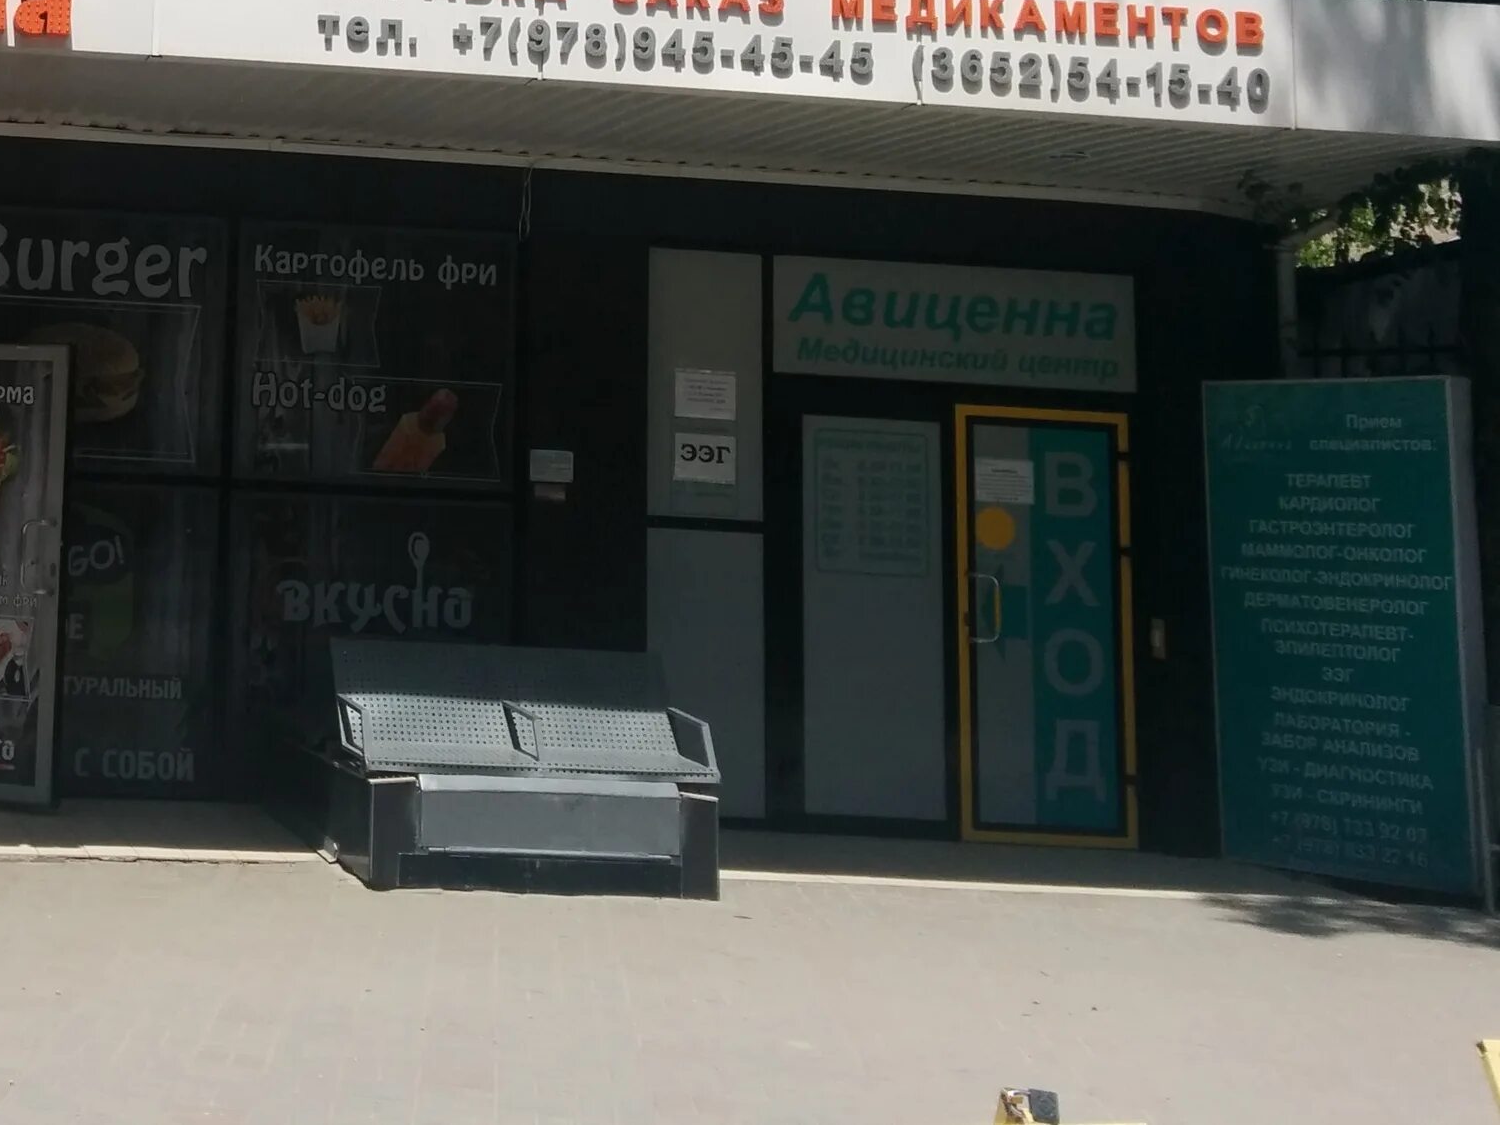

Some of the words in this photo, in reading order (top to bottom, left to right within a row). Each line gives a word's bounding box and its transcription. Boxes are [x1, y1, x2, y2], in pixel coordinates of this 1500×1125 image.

[317, 14, 417, 56] тел.
[453, 15, 874, 78] +7(978)945-45-45
[912, 44, 1270, 104] (3652)54-15-40
[254, 243, 425, 287] Картофель
[437, 254, 497, 290] фри
[788, 272, 1118, 342] Авиценна
[797, 336, 1008, 373] Медицинский
[1019, 353, 1118, 382] центр
[251, 372, 388, 414] Hot-dog
[680, 443, 731, 464] ЭЭГ
[1285, 473, 1372, 489] ТЕРАПЕВТ
[1278, 496, 1381, 513] КАРДИОЛОГ
[1250, 519, 1416, 539] ГАСТРОЭНТЕРОЛОГ
[1241, 542, 1427, 563] МАММОЛОГ-ОНКОЛОГ
[1244, 591, 1429, 615] ДЕРМАТОВЕНЕРОЛОГ
[1045, 452, 1107, 803] ВХОД
[63, 676, 183, 700] ТУРАЛЬНЫЙ
[1270, 686, 1412, 712] ЭНДОКРИНОЛОГ
[1322, 739, 1420, 762] АНАЛИЗОВ
[102, 747, 195, 781] СОБОЙ
